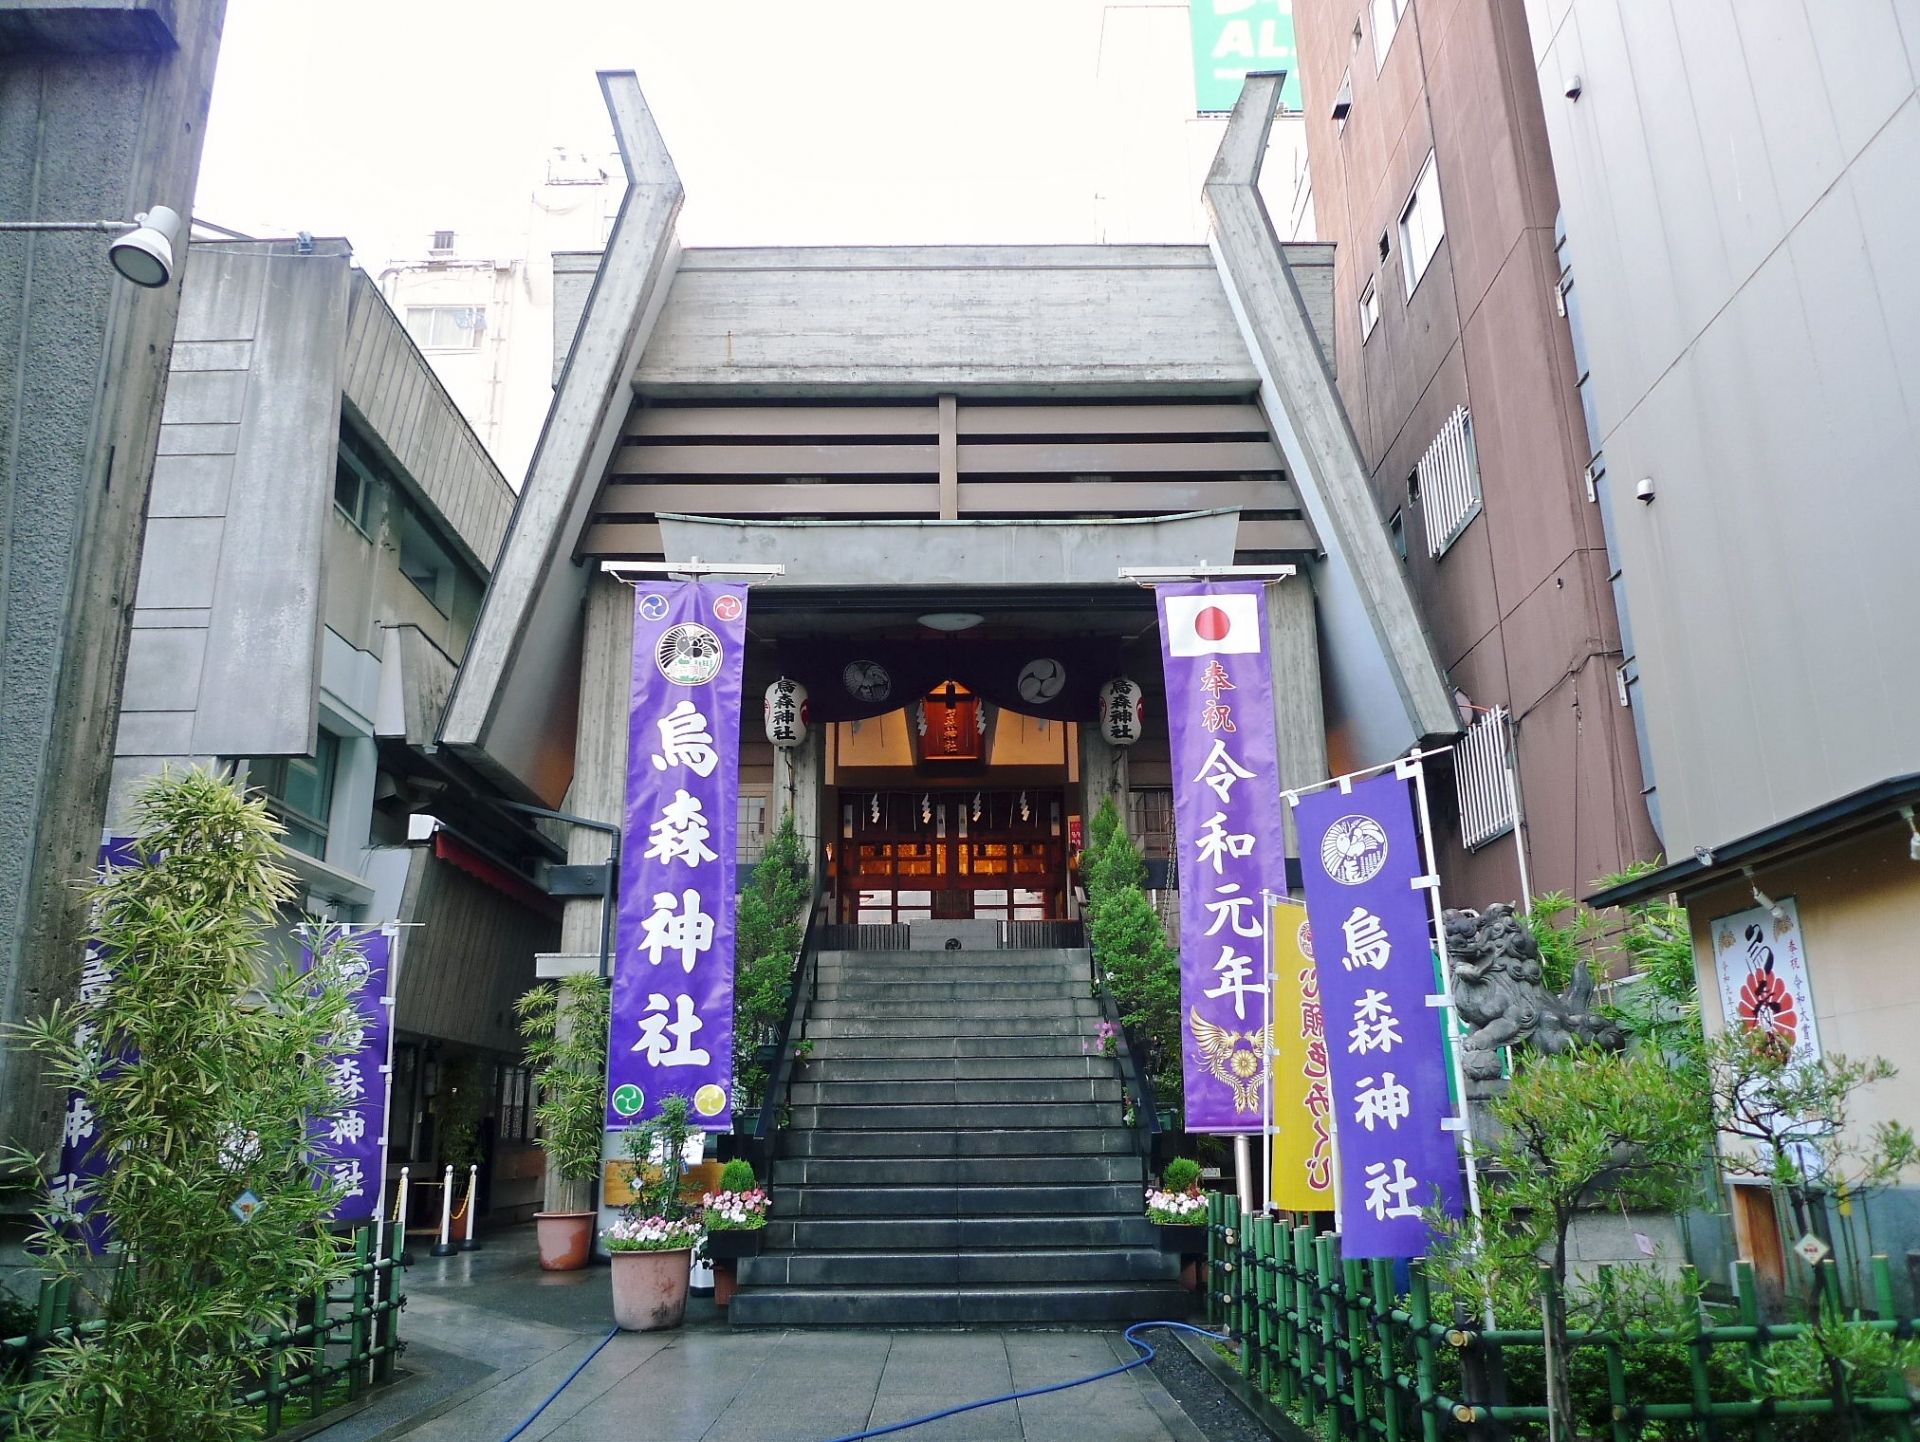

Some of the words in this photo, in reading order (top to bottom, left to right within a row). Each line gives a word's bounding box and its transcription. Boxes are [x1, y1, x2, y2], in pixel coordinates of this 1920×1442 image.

[1211, 19, 1297, 58] AL
[1200, 660, 1237, 733] 奉祝
[630, 699, 719, 1068] 烏森神社
[1193, 738, 1267, 1020] 令和元年
[1341, 906, 1424, 1221] 烏森神社
